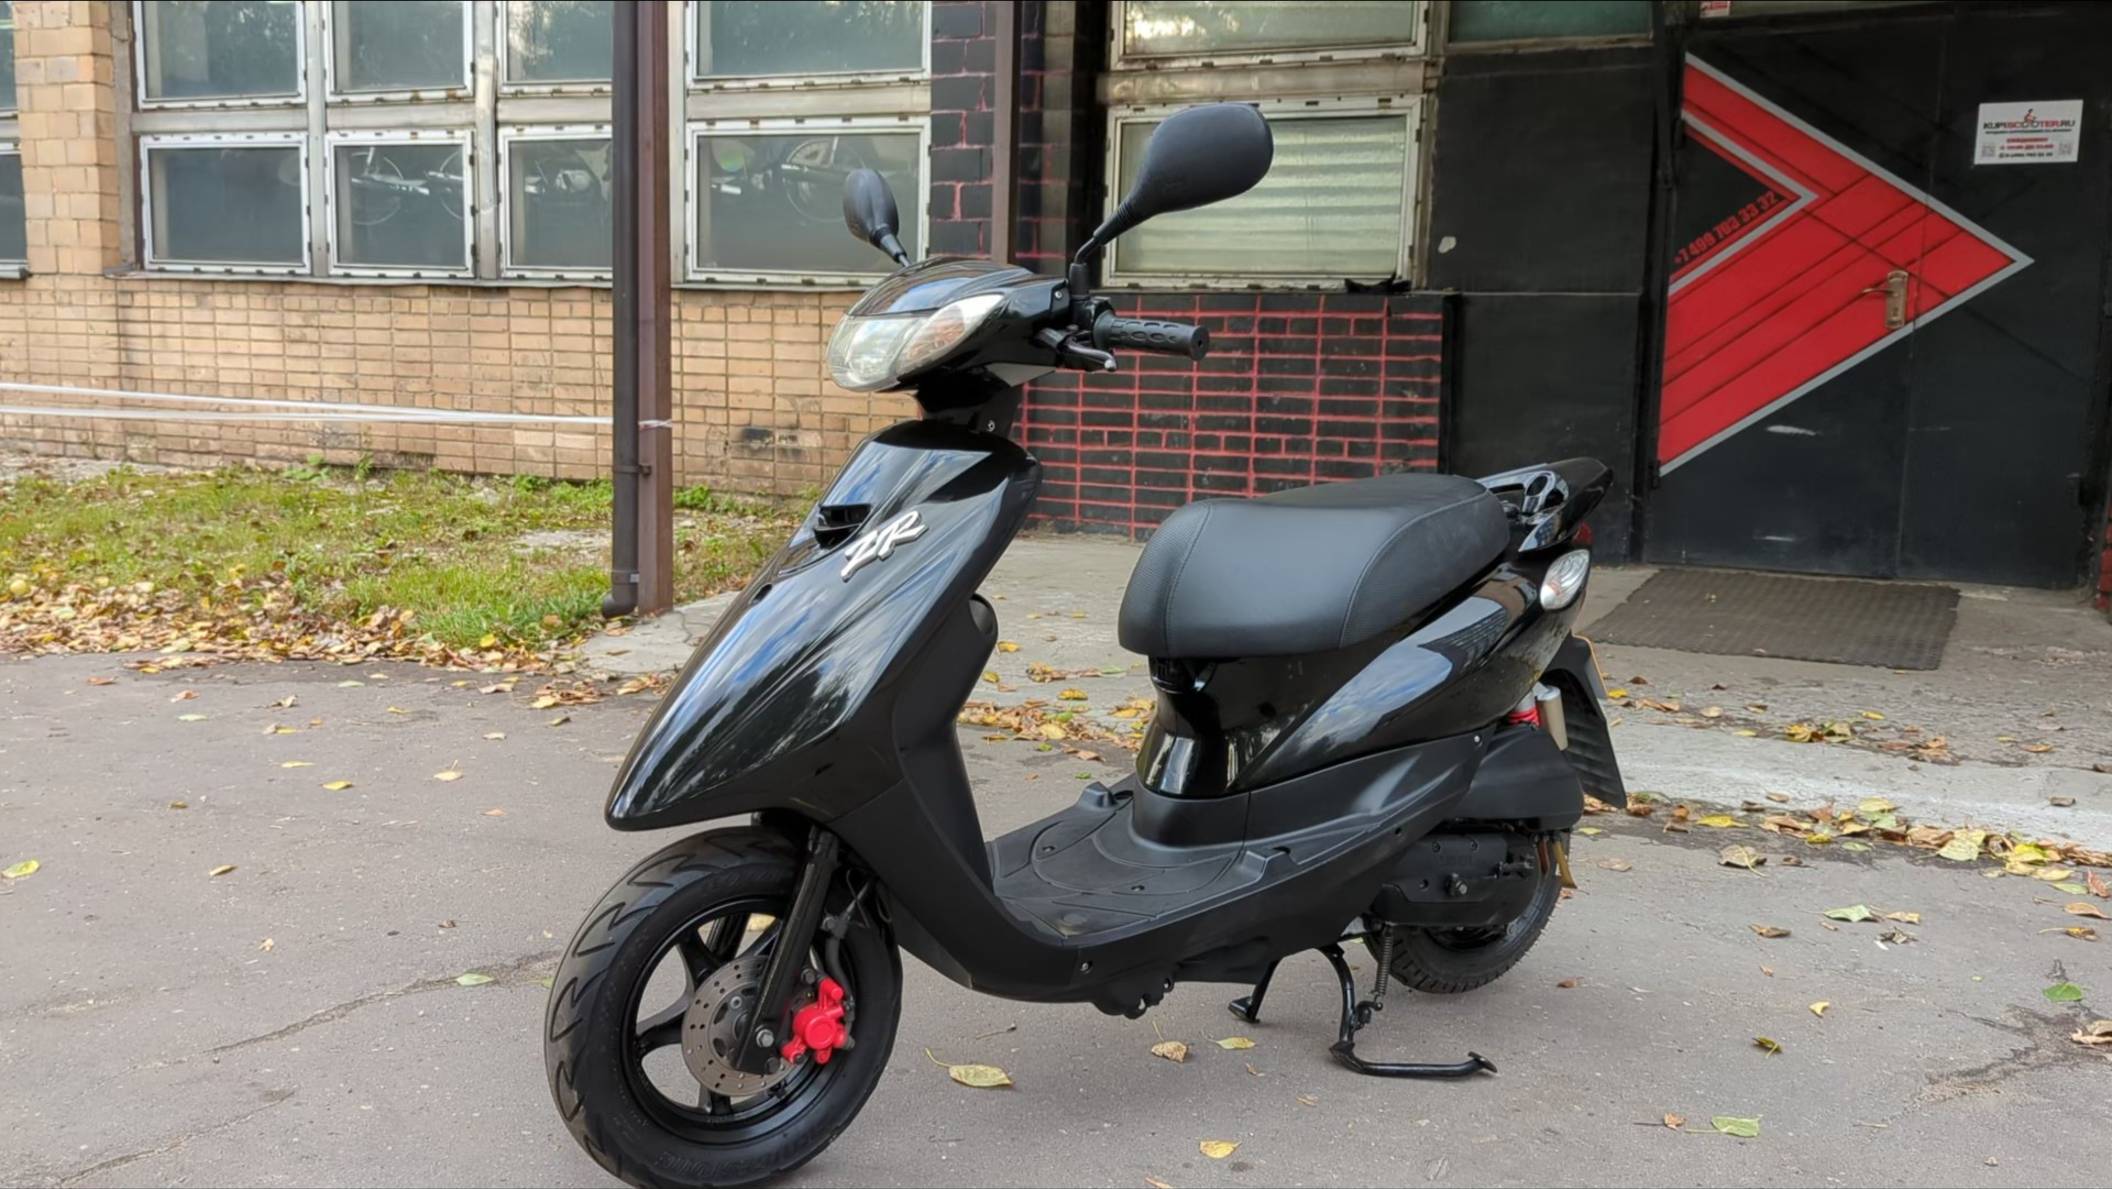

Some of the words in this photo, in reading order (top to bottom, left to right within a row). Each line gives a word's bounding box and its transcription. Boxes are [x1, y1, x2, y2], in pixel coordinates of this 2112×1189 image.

[1689, 232, 1716, 254] 499
[1713, 216, 1740, 238] 703
[1738, 203, 1759, 222] 33
